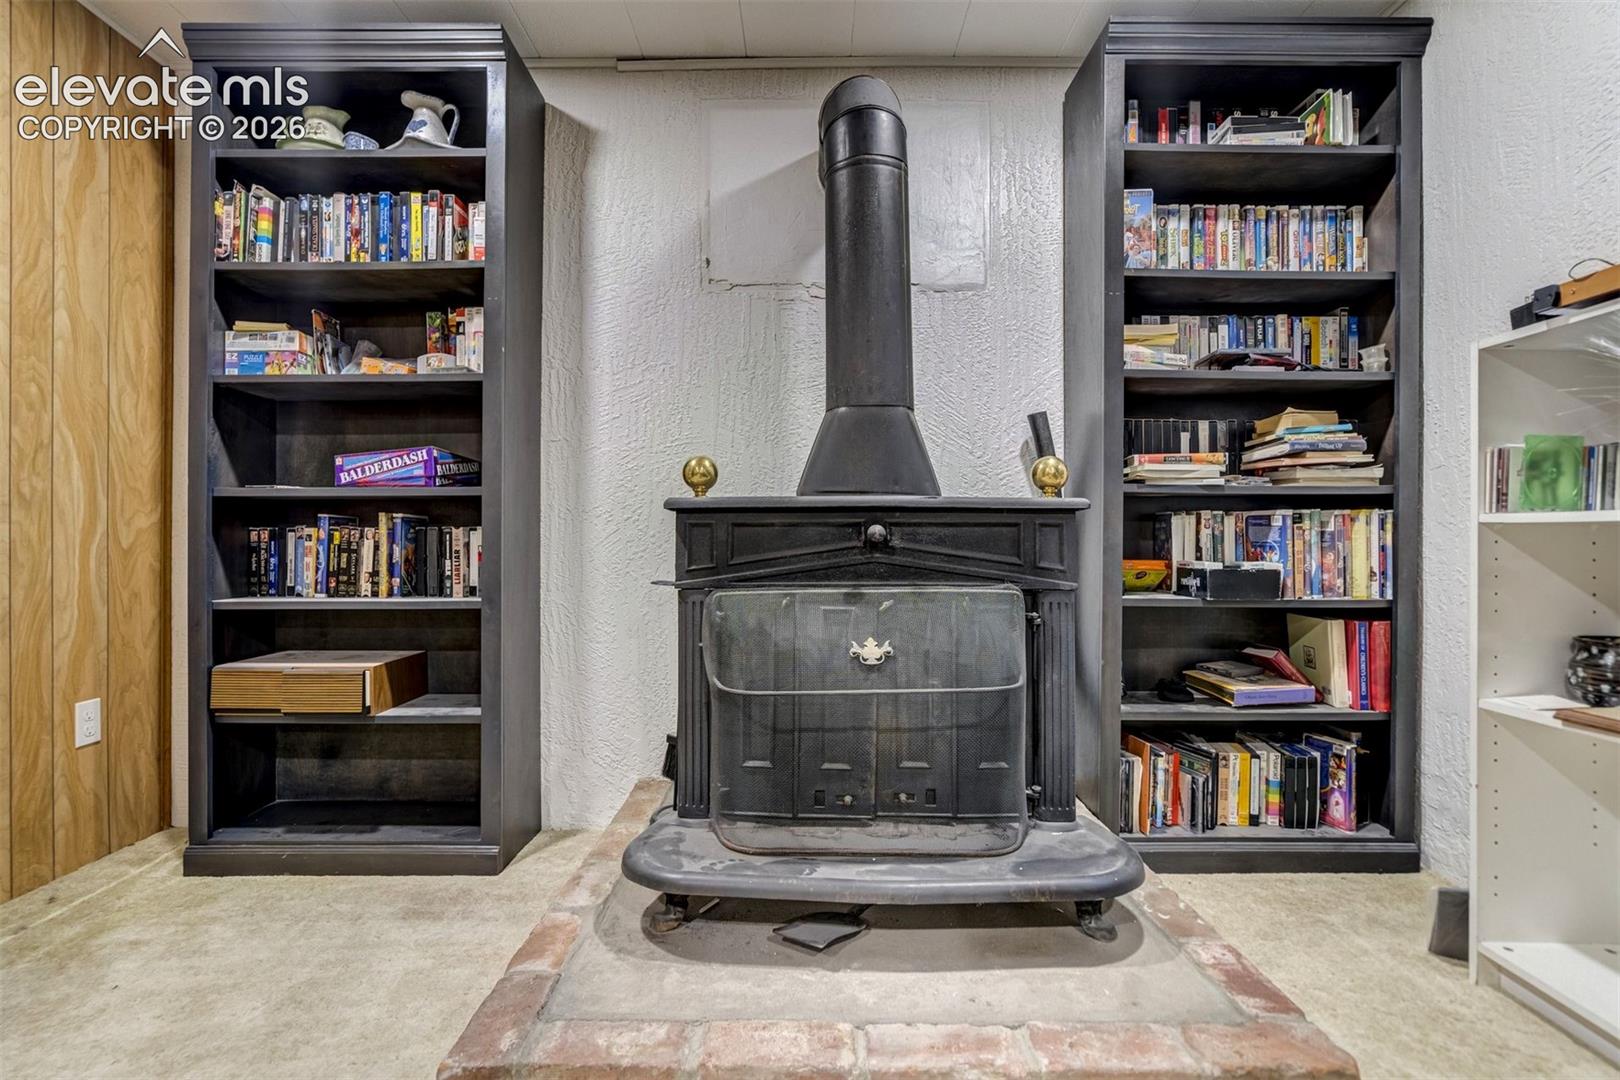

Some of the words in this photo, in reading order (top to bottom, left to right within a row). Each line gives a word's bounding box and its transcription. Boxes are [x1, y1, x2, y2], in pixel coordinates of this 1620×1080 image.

[225, 352, 238, 360] EZ
[340, 449, 429, 485] BALDERDASH
[436, 462, 480, 476] BALDERDASH
